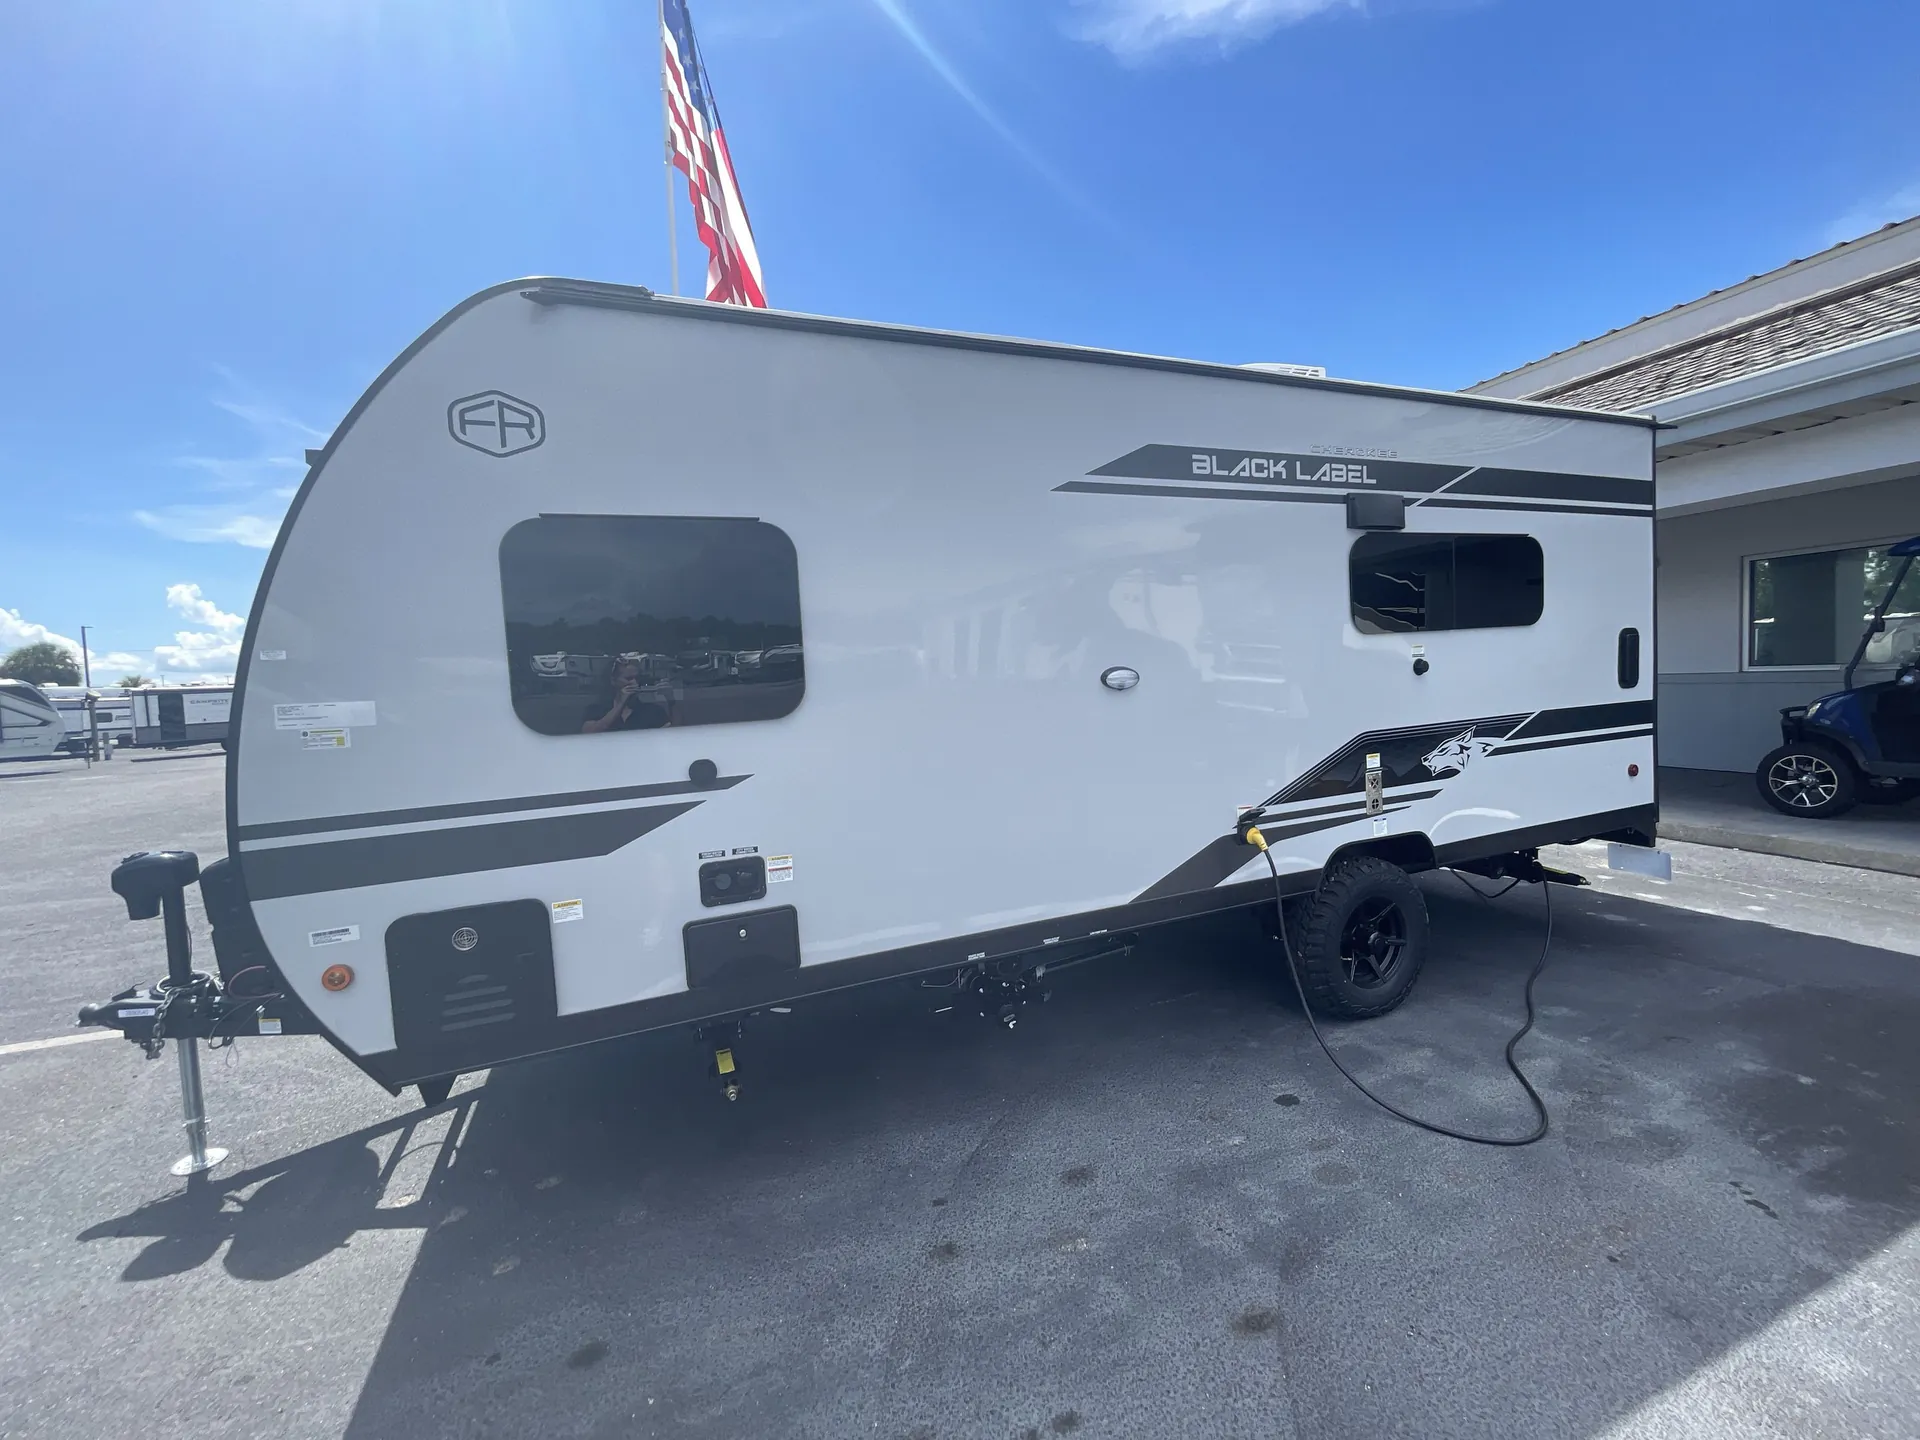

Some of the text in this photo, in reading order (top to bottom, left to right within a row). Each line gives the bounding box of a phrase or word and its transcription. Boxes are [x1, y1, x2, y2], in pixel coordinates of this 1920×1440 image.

[1310, 443, 1398, 459] CHEROKEE
[1191, 453, 1377, 485] BLACK LABEL
